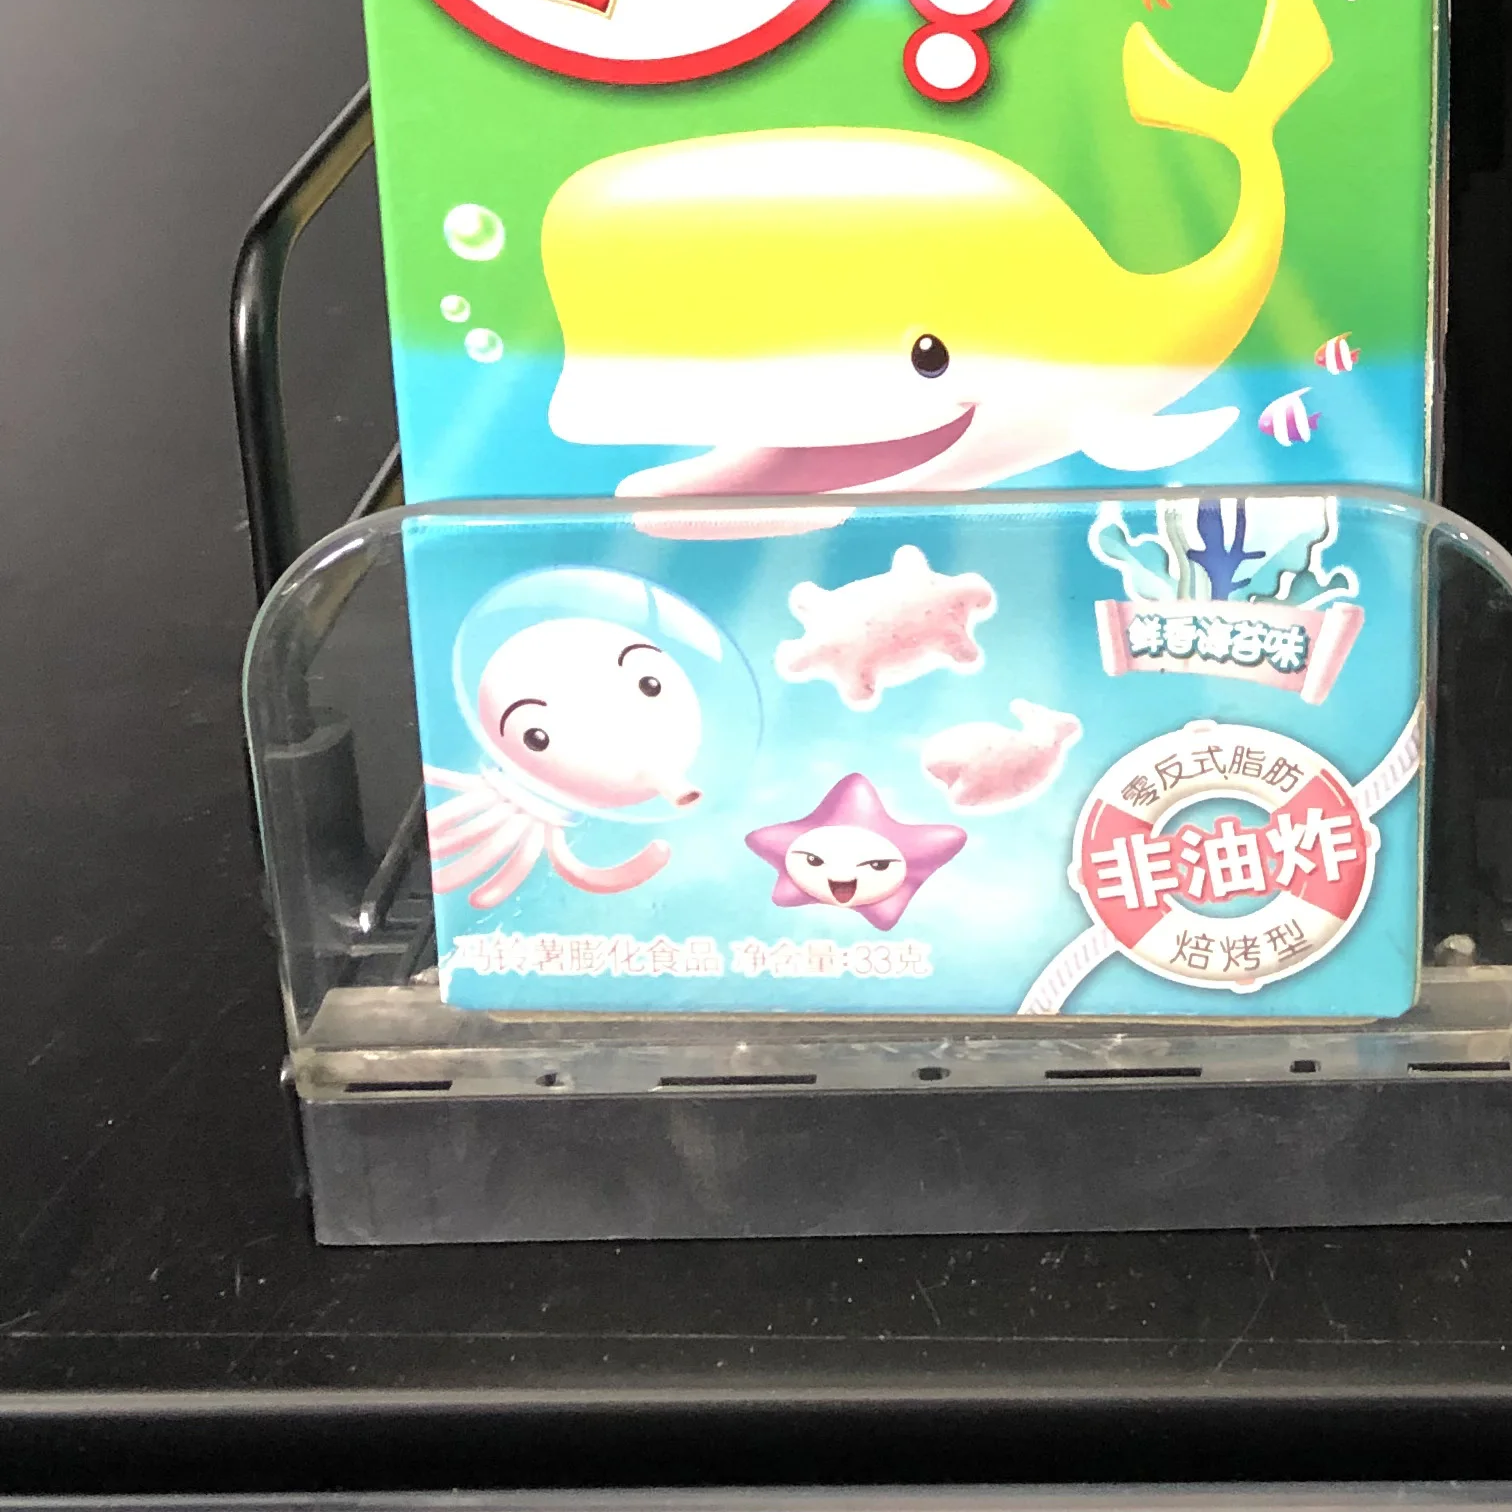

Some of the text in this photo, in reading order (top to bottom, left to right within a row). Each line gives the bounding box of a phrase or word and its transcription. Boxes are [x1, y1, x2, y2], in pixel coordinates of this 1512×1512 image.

[1127, 614, 1309, 673] 鲜香海苔味
[1120, 745, 1306, 808] 零反式脂肪
[1090, 806, 1358, 910] 非油炸
[1169, 918, 1316, 973] 焙烤型
